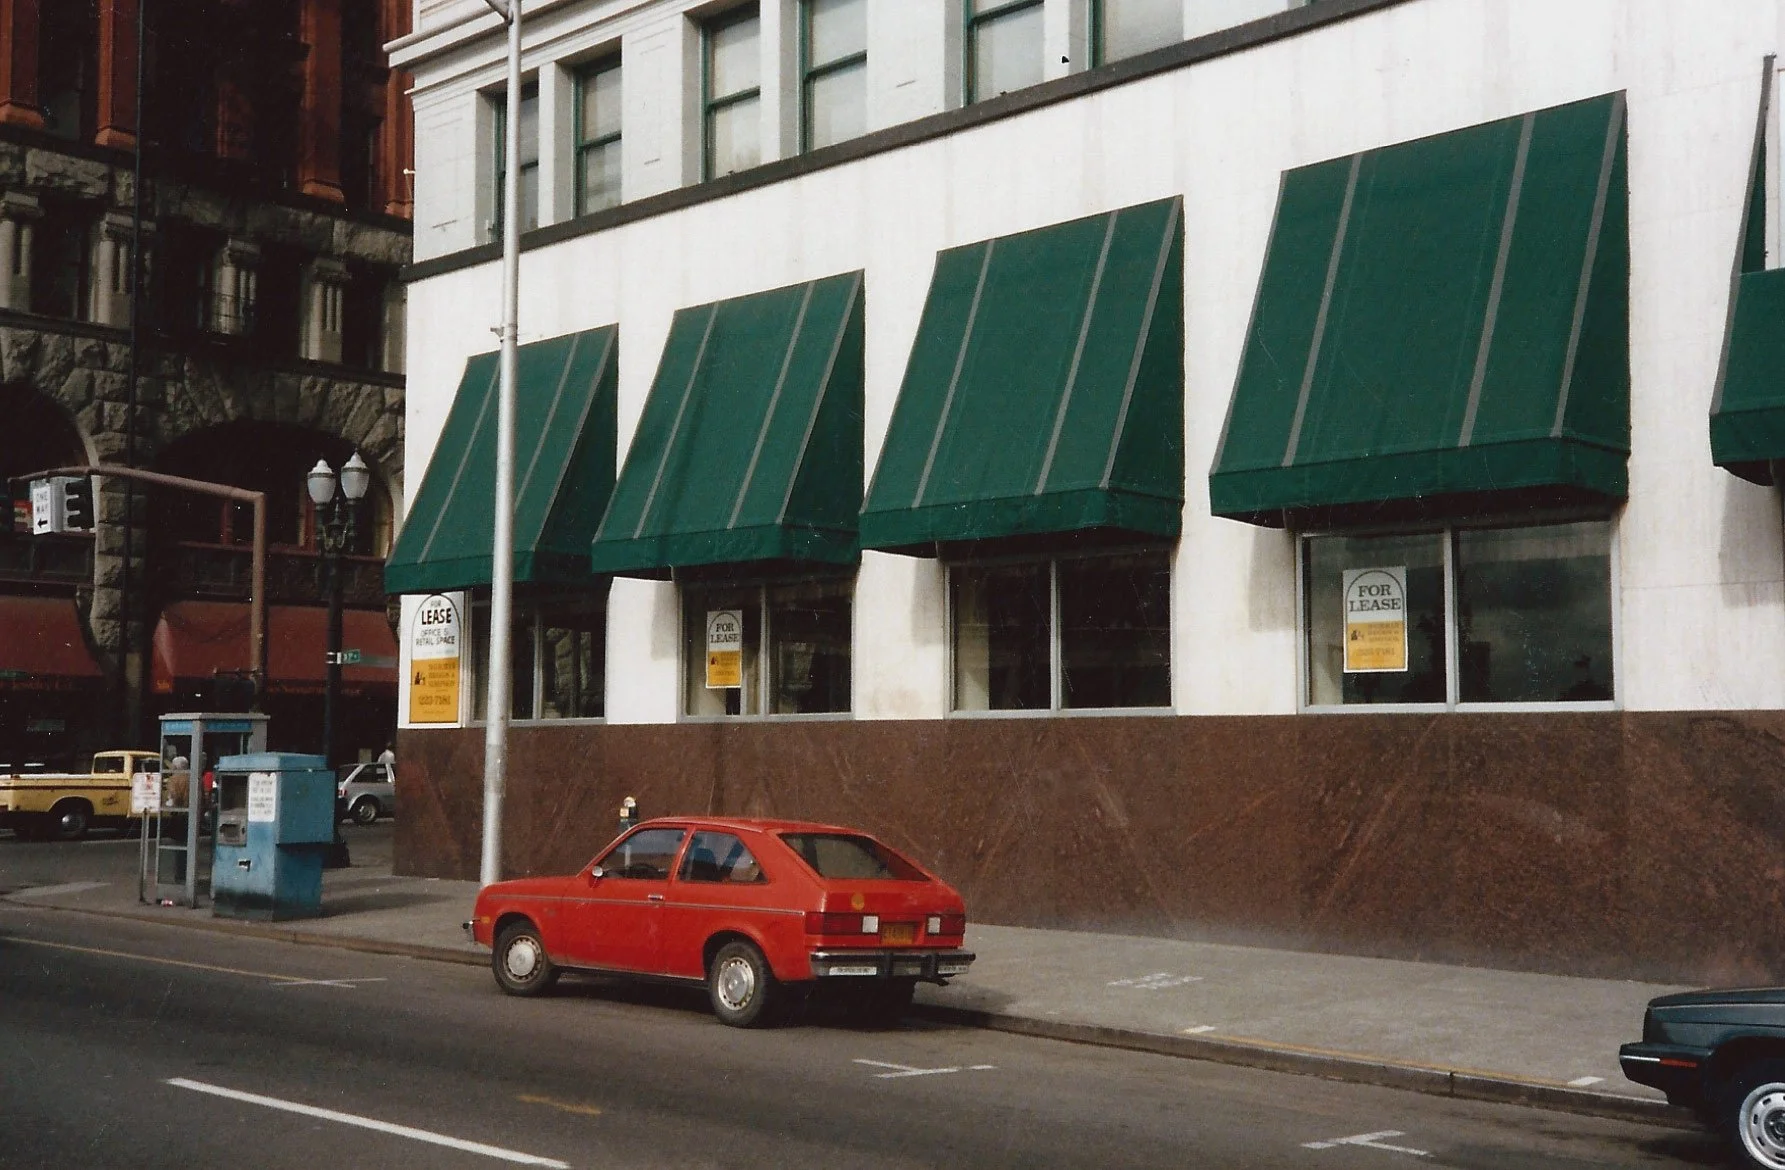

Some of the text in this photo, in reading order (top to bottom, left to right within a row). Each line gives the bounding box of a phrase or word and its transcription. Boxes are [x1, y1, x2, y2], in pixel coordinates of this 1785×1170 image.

[1358, 584, 1392, 598] FOR
[1349, 598, 1401, 613] LEASE
[421, 608, 452, 626] LEASE
[715, 623, 735, 633] FOR
[710, 633, 740, 644] LEASE
